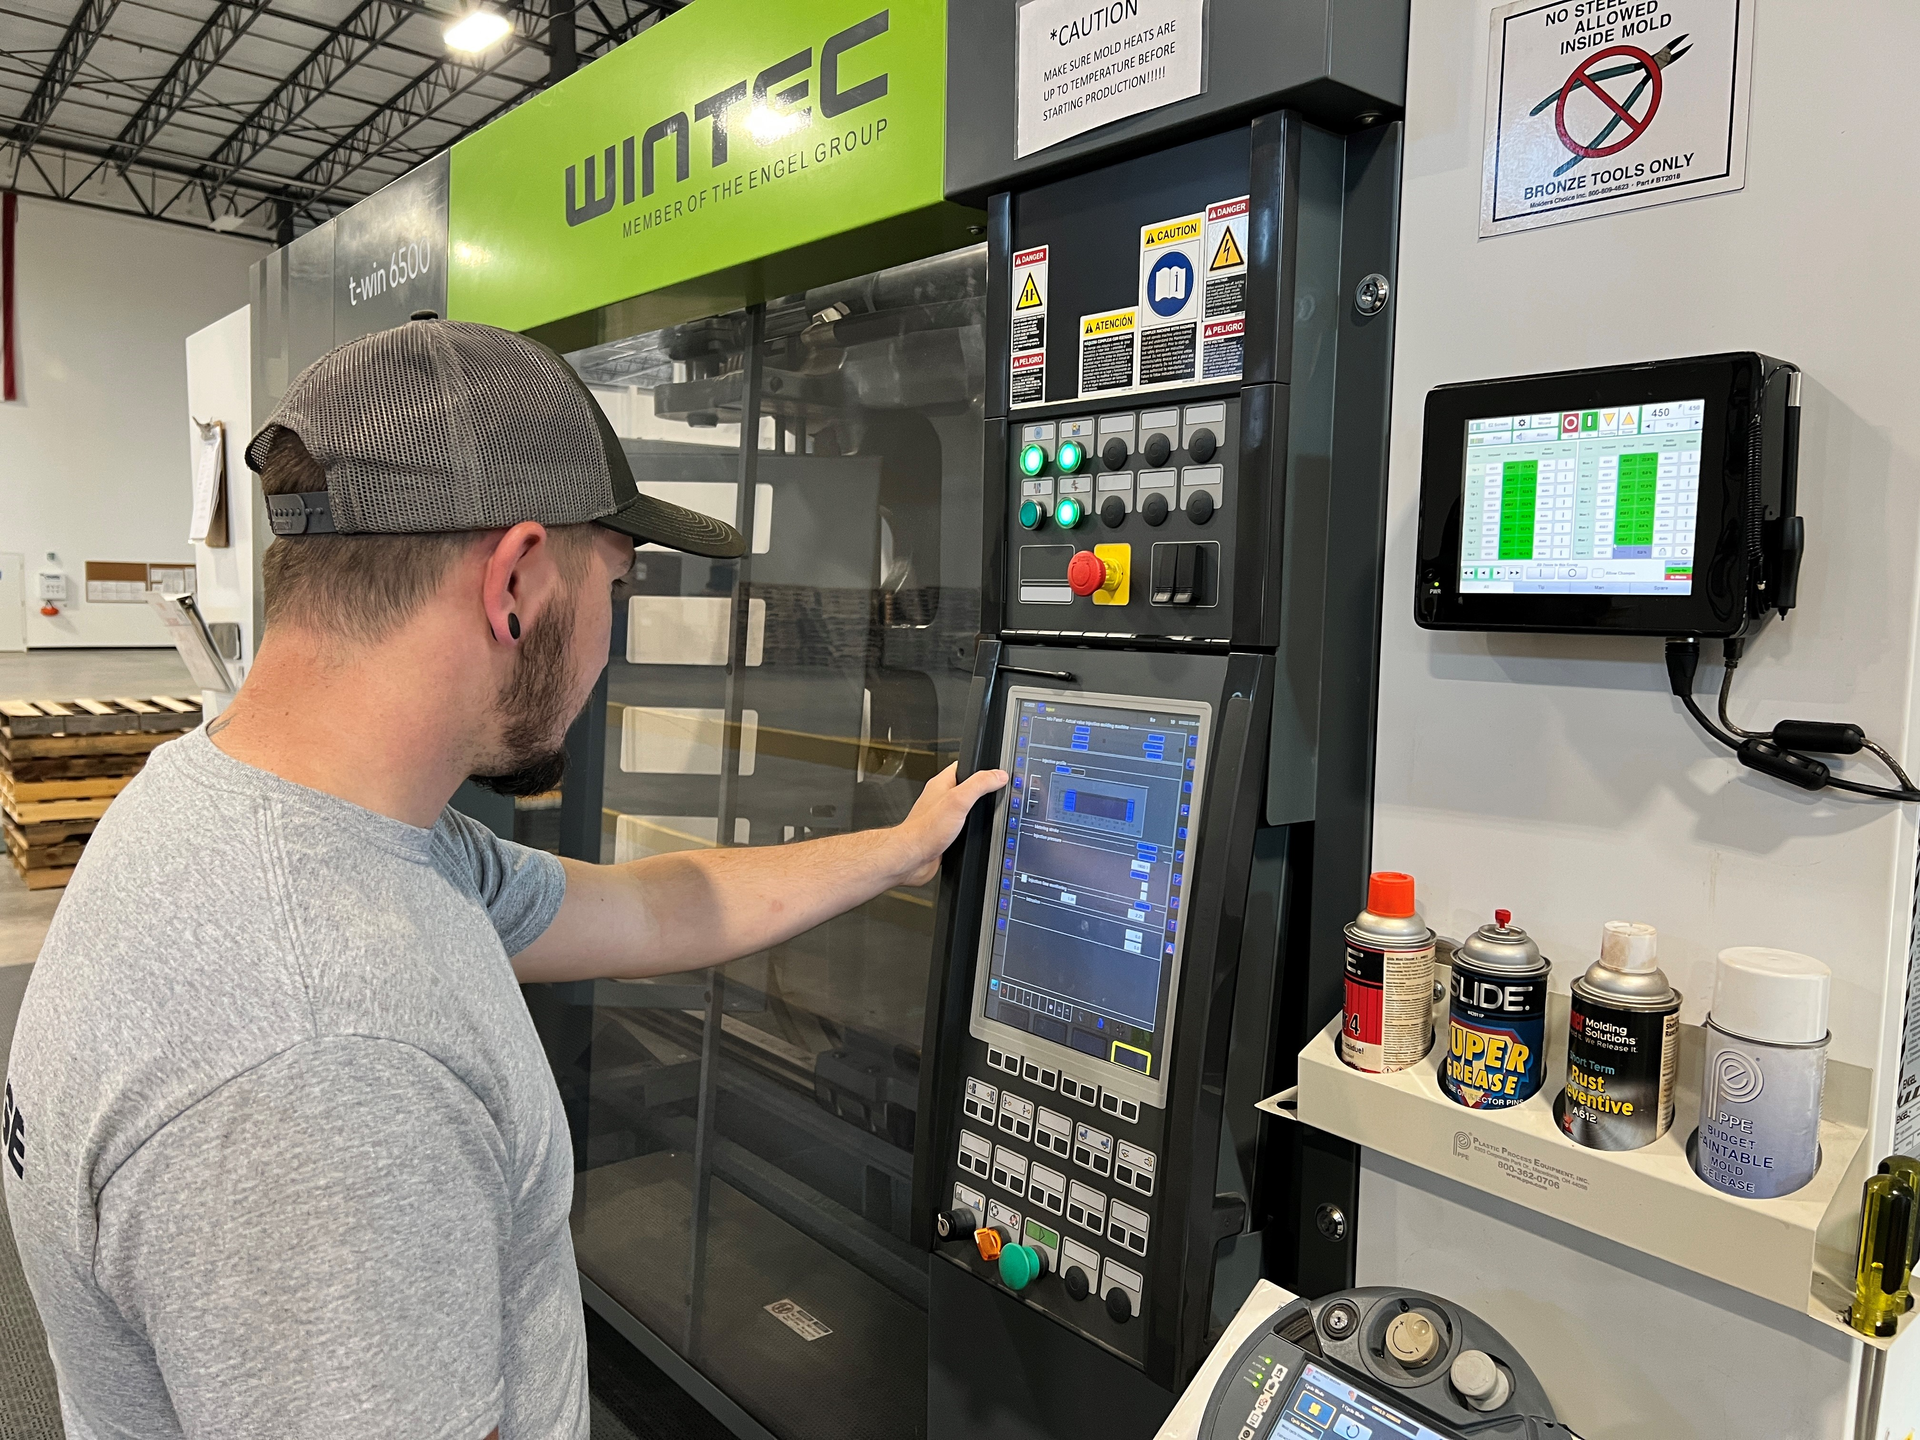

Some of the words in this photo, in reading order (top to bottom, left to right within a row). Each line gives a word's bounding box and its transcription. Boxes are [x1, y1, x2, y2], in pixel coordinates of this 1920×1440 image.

[1545, 9, 1568, 26] NO
[1574, 0, 1658, 35] ALLOWED
[1560, 28, 1615, 55] INSIDE
[1621, 13, 1672, 38] MOLD
[1043, 62, 1067, 82] MAKE
[1069, 53, 1092, 72] SURE
[1093, 42, 1122, 62] MOLD
[1124, 28, 1154, 50] HEATS
[1156, 19, 1177, 37] ARE
[1043, 87, 1056, 102] UP
[1057, 83, 1069, 97] TO
[1070, 57, 1136, 91] TEMPERATURE
[1138, 41, 1176, 65] BEFORE
[1043, 96, 1083, 121] STARTING
[1085, 66, 1166, 104] PRODUCTION!!!!!
[565, 9, 889, 228] WINTEC
[622, 200, 684, 239] MEMBER
[687, 189, 708, 213] OF
[712, 175, 744, 205] THE
[749, 151, 809, 190] ENGEL
[814, 118, 888, 163] GROUP
[1524, 175, 1587, 200] BRONZE
[1590, 163, 1645, 186] TOOLS
[1649, 152, 1695, 174] ONLY
[1636, 179, 1650, 187] Part
[1217, 202, 1246, 217] DANGER
[1157, 223, 1197, 241] CAUTION
[1021, 251, 1044, 263] DANGER
[349, 261, 387, 306] t-win
[389, 237, 430, 288] 6500
[1094, 314, 1133, 332] ATENCIÓN
[1212, 322, 1244, 335] PELIGRO
[1019, 355, 1043, 366] PELIGRO
[1651, 408, 1670, 417] 450
[1585, 1027, 1636, 1045] Solutions
[1586, 1017, 1628, 1036] Molding
[1451, 1025, 1530, 1073] UPER
[1597, 1040, 1629, 1052] Release
[1447, 1057, 1518, 1095] GREASE
[1571, 1064, 1605, 1092] Rust
[1589, 1060, 1615, 1075] Term
[1572, 1106, 1597, 1123] A612
[1719, 1111, 1753, 1135] PPE
[1707, 1124, 1756, 1149] BUDGET
[1497, 1160, 1560, 1189] 800-362-0706
[1710, 1156, 1744, 1176] MOLD
[1702, 1164, 1755, 1193] RELEASE
